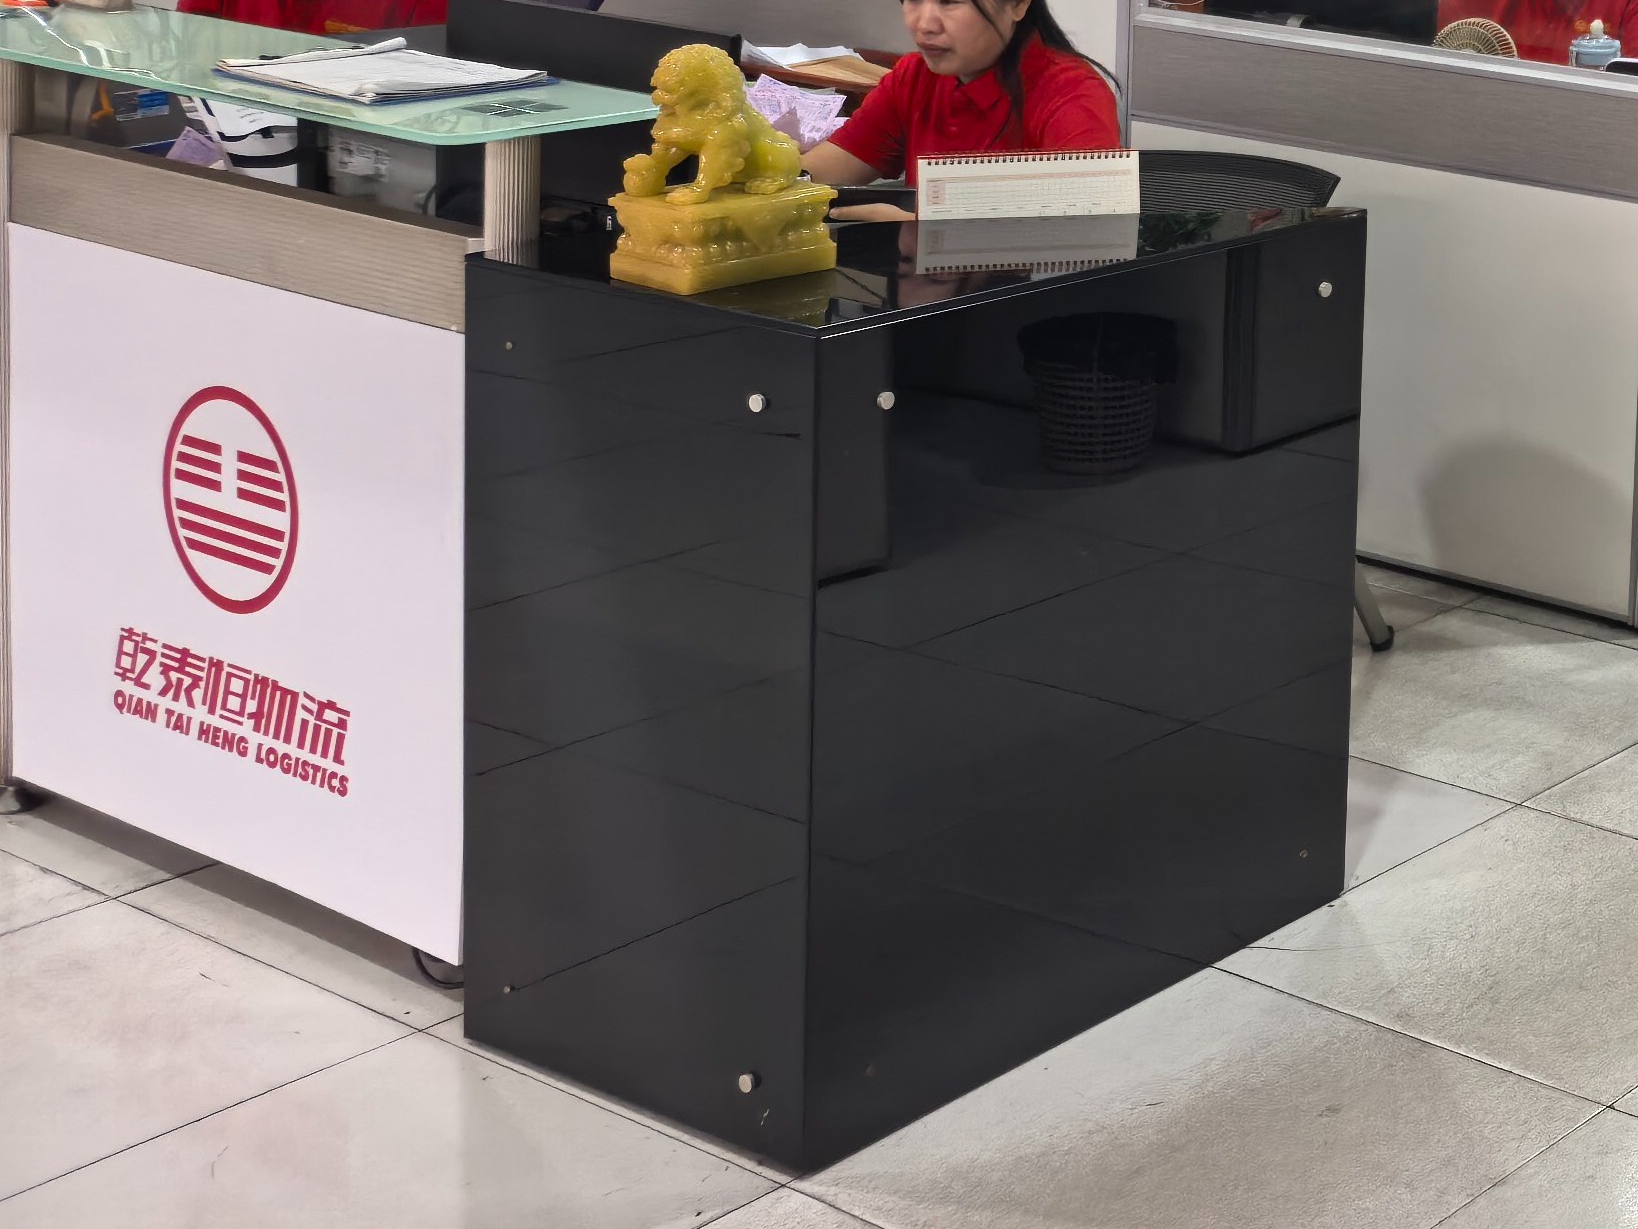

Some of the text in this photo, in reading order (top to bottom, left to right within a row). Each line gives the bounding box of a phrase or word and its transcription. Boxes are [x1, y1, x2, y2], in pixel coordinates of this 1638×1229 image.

[113, 627, 351, 766] 乾泰恒物流
[113, 689, 349, 798] QIAN TAI HENG LOGISTICS
